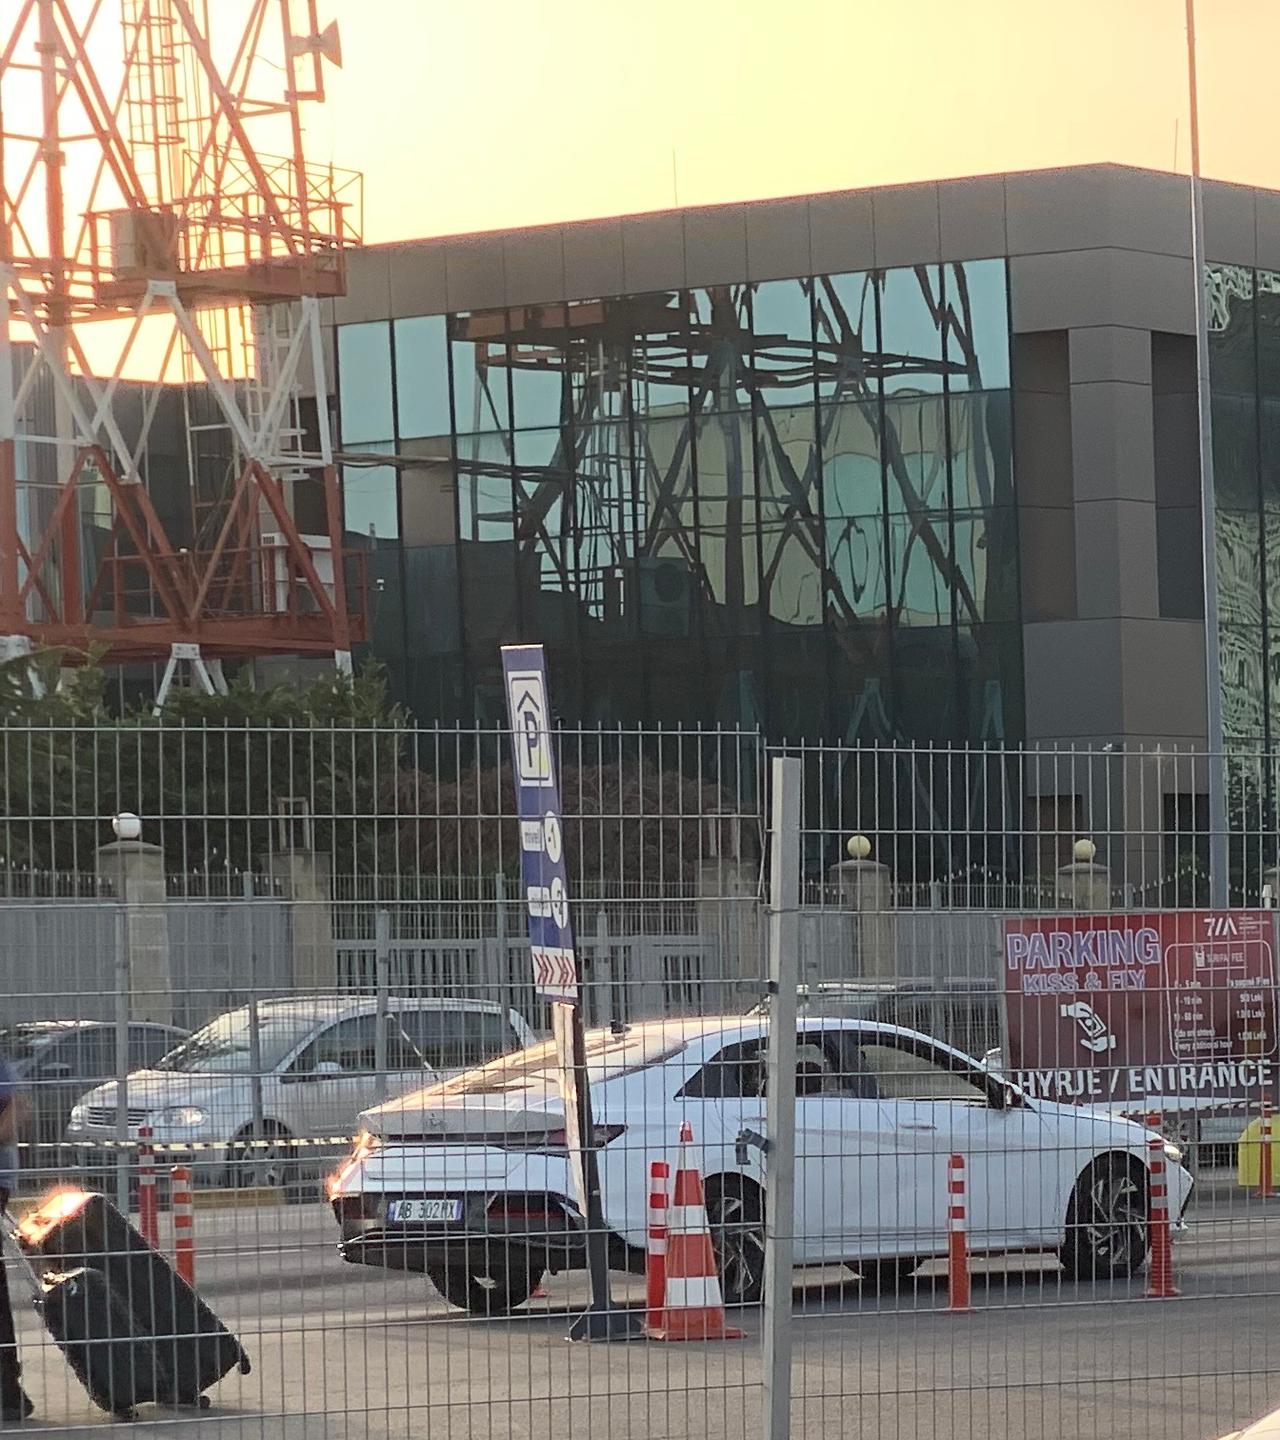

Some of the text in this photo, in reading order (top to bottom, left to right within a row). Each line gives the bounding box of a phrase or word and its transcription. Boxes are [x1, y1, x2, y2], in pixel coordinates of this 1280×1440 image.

[1006, 927, 1161, 970] PARKING
[1023, 969, 1146, 996] KISS & FLY
[1017, 1068, 1102, 1098] HYRJE
[1129, 1059, 1273, 1093] ENTRANCE
